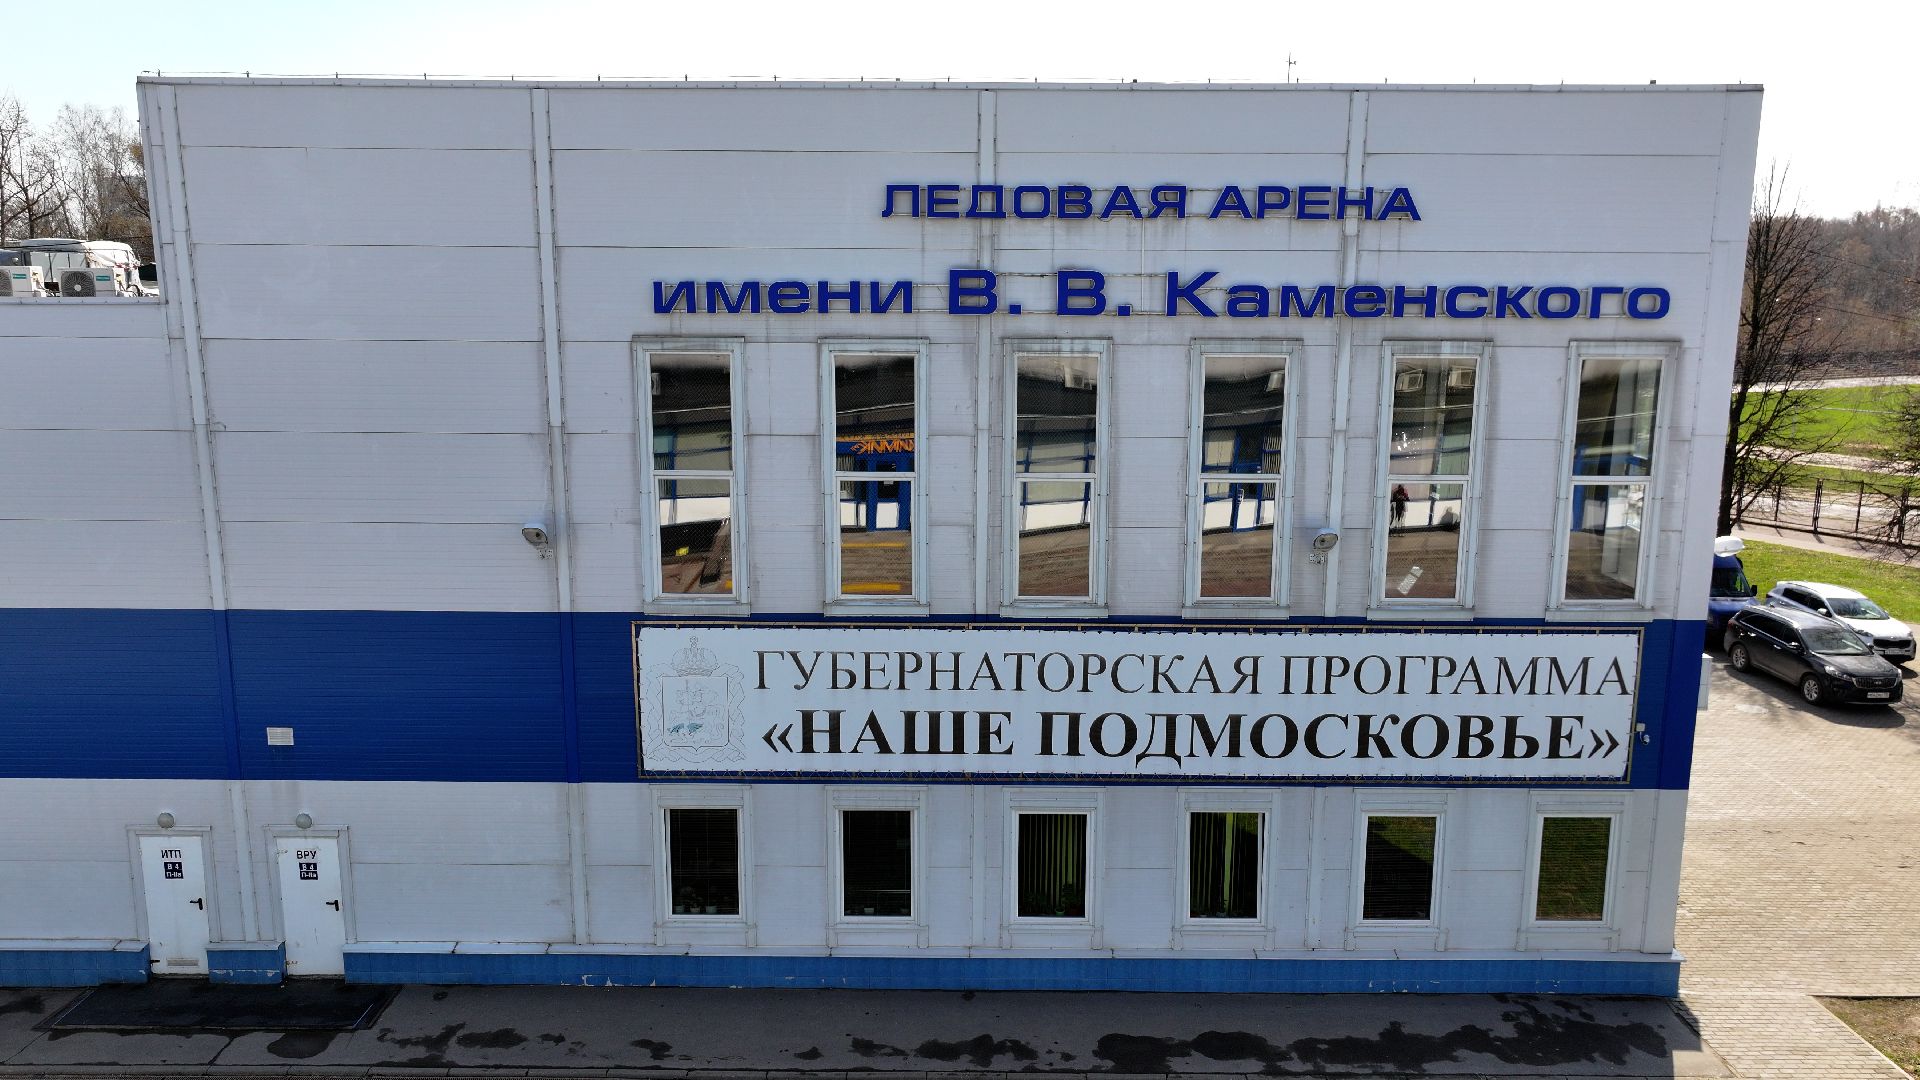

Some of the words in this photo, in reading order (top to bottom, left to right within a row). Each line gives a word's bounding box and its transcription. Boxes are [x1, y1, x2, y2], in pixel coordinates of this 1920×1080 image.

[881, 184, 1186, 219] ЛЕДОВАЯ
[1209, 185, 1421, 220] АРЕНА
[653, 280, 914, 314] имени
[948, 269, 1022, 315] В.
[1056, 270, 1132, 316] В.
[1166, 271, 1671, 319] Каменского
[753, 650, 1265, 695] ГУБЕРНАТОРСКАЯ
[1278, 654, 1633, 697] ПРОГРАММА
[761, 709, 1014, 756] «НАШЕ
[1034, 711, 1620, 770] ПОДМОСКОВЬЕ»
[161, 849, 182, 859] ИТП
[296, 850, 317, 860] ВРУ
